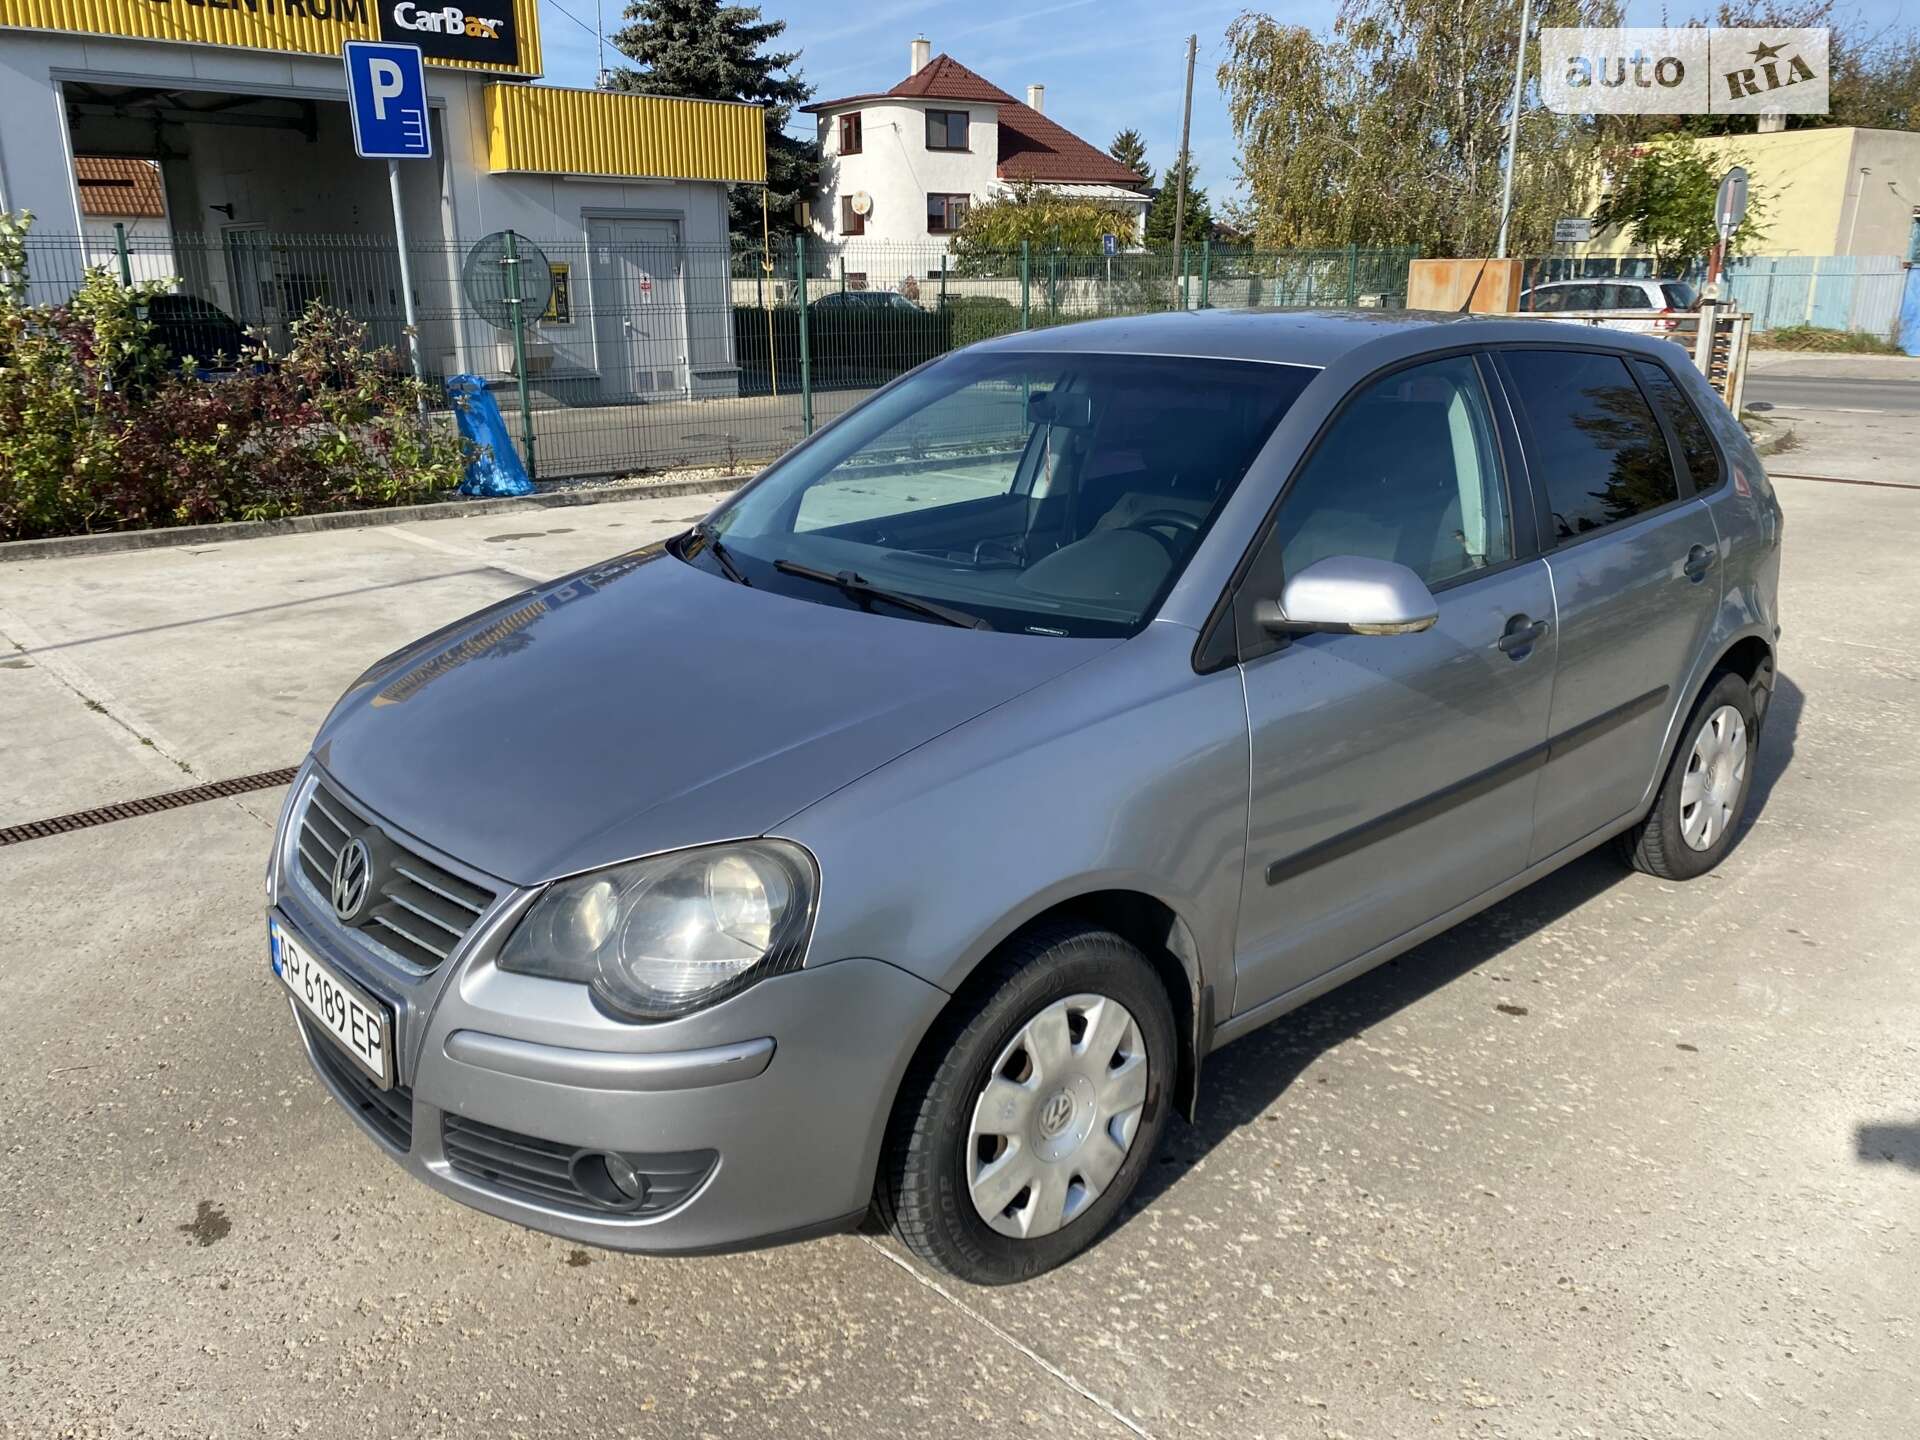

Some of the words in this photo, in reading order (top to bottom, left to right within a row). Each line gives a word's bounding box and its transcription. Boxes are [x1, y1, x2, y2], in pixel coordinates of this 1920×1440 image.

[183, 0, 369, 25] TRUM
[393, 1, 503, 39] CarBax
[368, 57, 404, 120] P
[280, 935, 300, 983] AP
[304, 961, 346, 1033] 6189
[350, 1000, 382, 1059] EP
